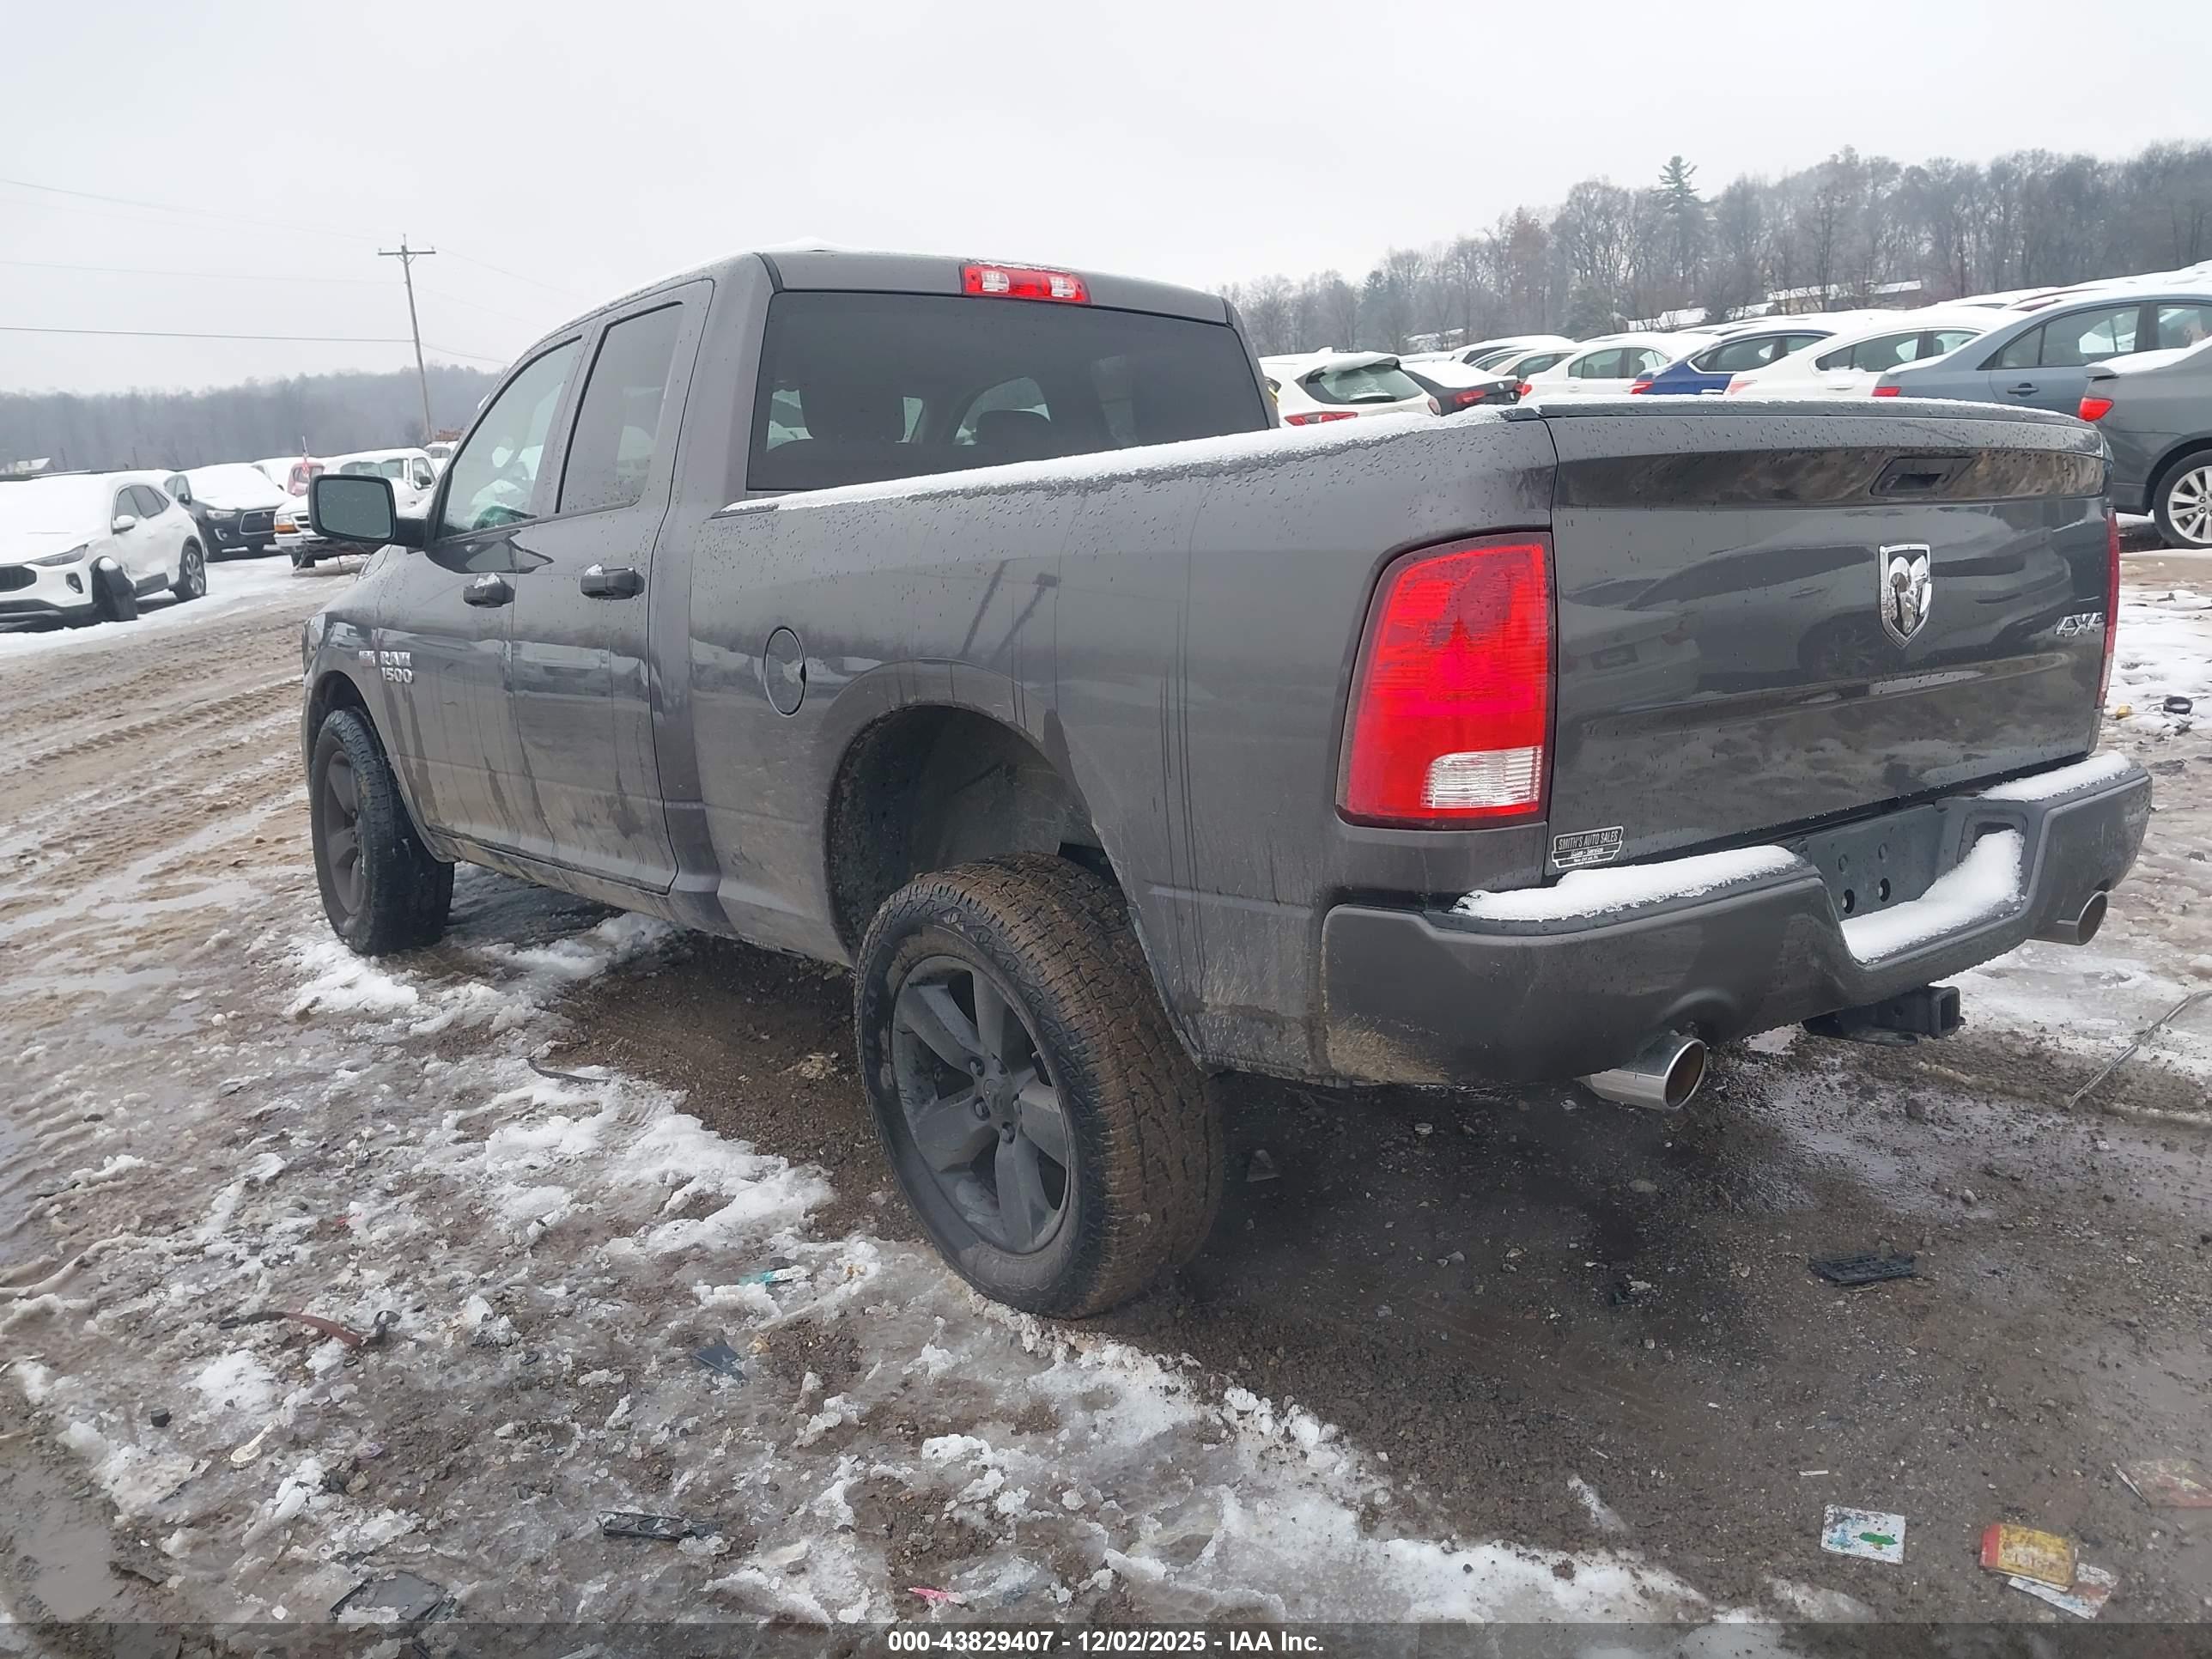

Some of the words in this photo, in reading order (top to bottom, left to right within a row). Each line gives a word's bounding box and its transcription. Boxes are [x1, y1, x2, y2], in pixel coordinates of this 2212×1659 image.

[380, 650, 411, 666] RAM
[380, 666, 414, 684] 1500
[1559, 836, 1583, 850] SMITH'S
[1583, 833, 1600, 846] AUTO
[1601, 830, 1619, 843] SALES
